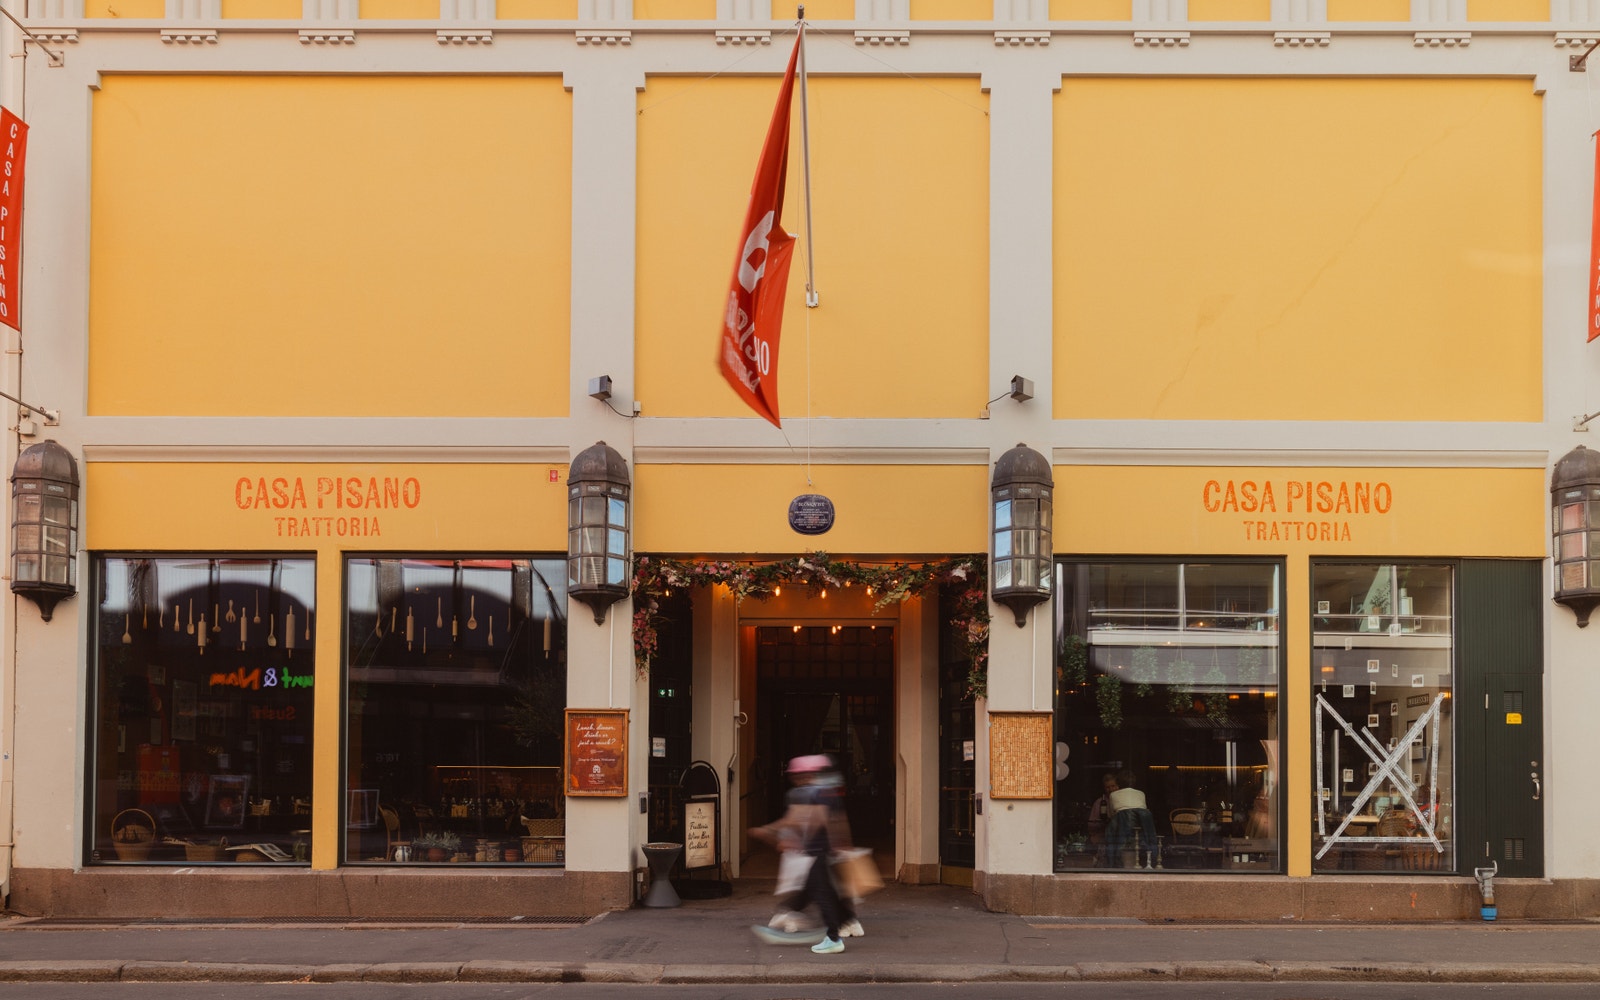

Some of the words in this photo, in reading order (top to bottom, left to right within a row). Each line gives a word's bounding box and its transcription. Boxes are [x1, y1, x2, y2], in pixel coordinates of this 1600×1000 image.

[2, 123, 18, 197] CASA
[235, 476, 308, 510] CASA
[317, 476, 421, 510] PISANO
[1203, 479, 1277, 513] CASA
[1287, 481, 1393, 515] PISANO
[274, 516, 381, 537] TRATTORIA
[1243, 520, 1352, 542] TRATTORIA
